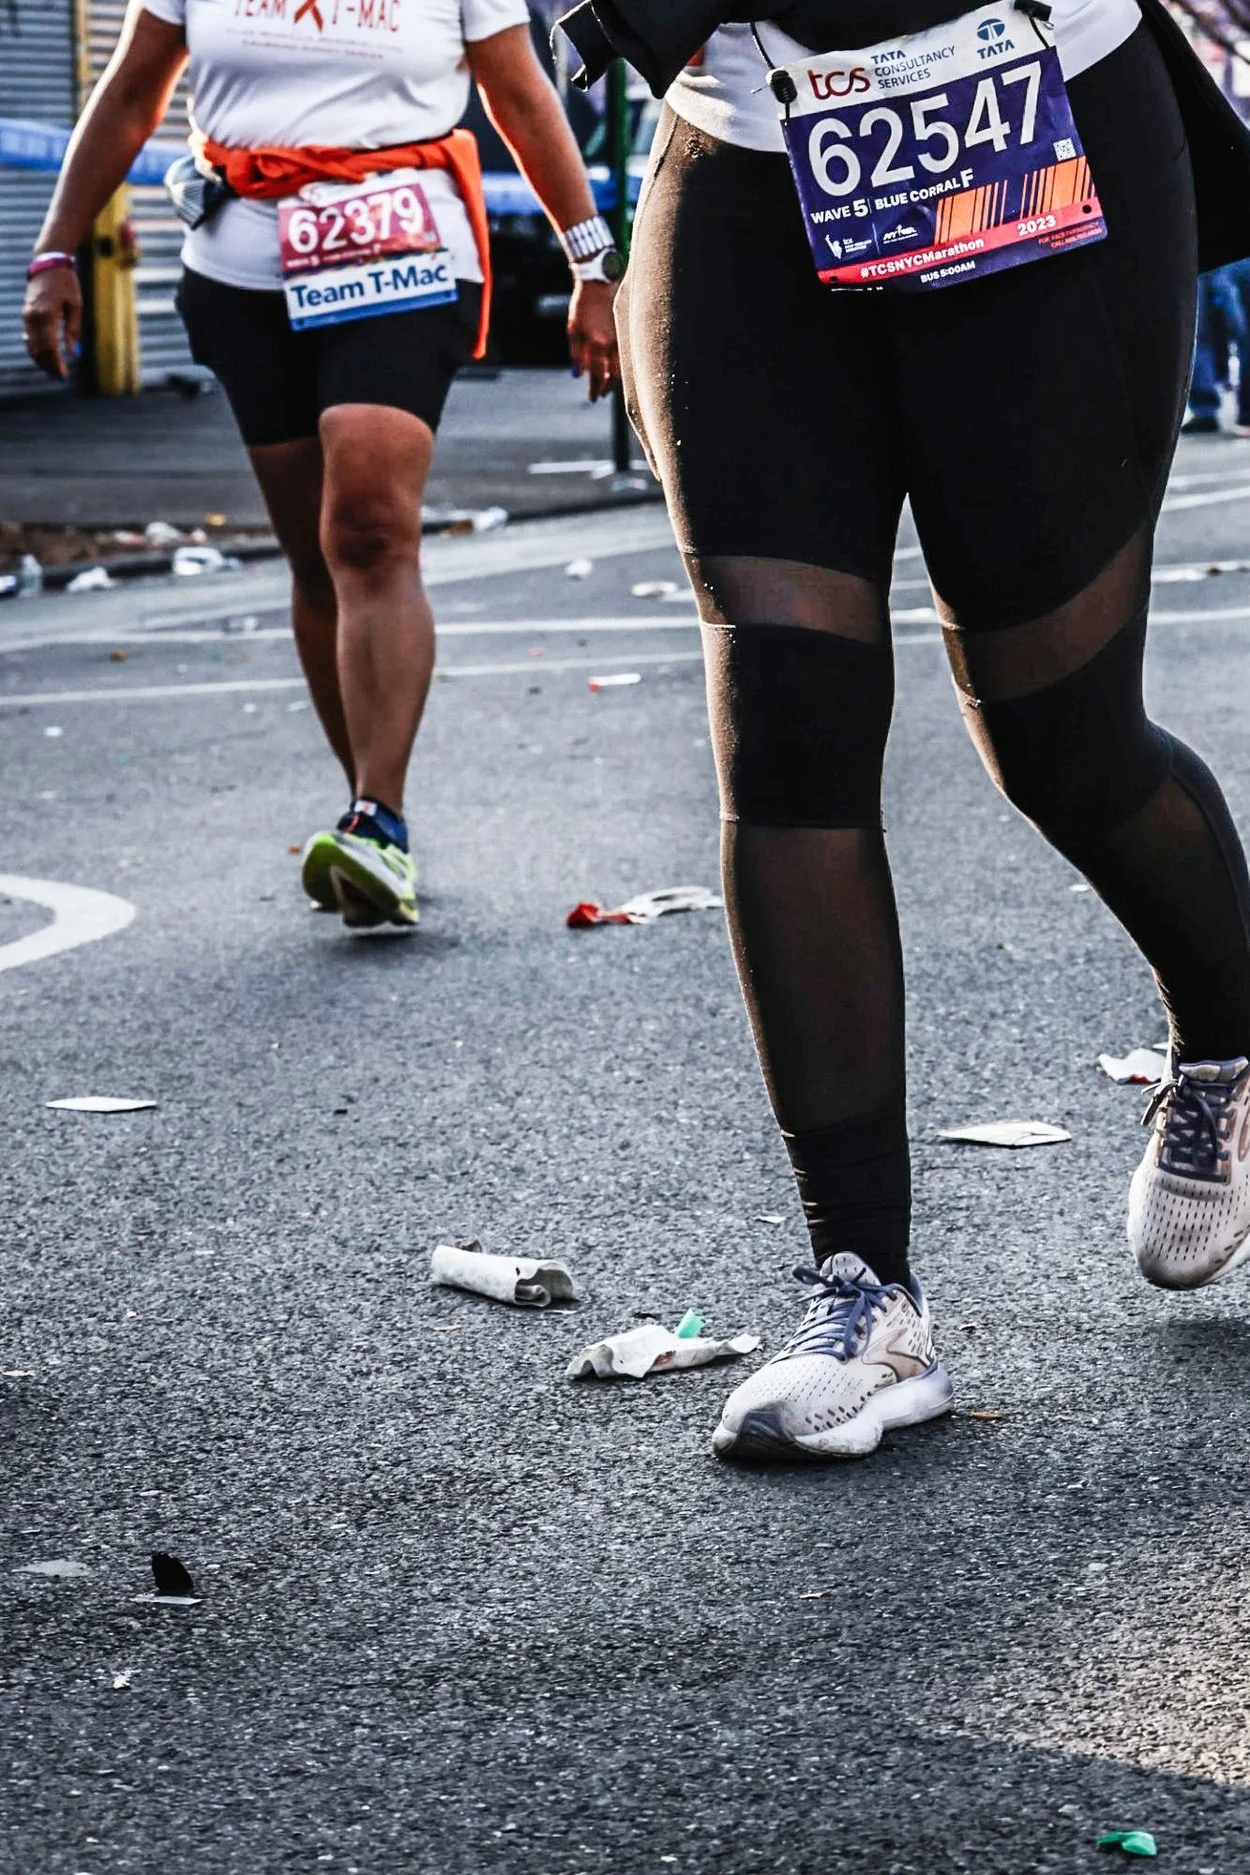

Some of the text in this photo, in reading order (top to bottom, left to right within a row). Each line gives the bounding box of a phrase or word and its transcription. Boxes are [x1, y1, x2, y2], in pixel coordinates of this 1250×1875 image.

[871, 50, 906, 64] TATA
[874, 45, 956, 77] CONSULTANCY
[977, 39, 1015, 60] TATA
[808, 67, 871, 101] tcs
[878, 68, 931, 89] SERVICES
[808, 60, 1042, 197] 62547
[810, 169, 974, 224] WAVE 5 BLUE CORRAL F
[288, 187, 425, 254] 62379
[1017, 215, 1057, 236] 2023
[860, 238, 985, 278] #TCSNYCMarathon
[290, 262, 449, 309] Team T-Mac
[920, 272, 940, 283] BUS
